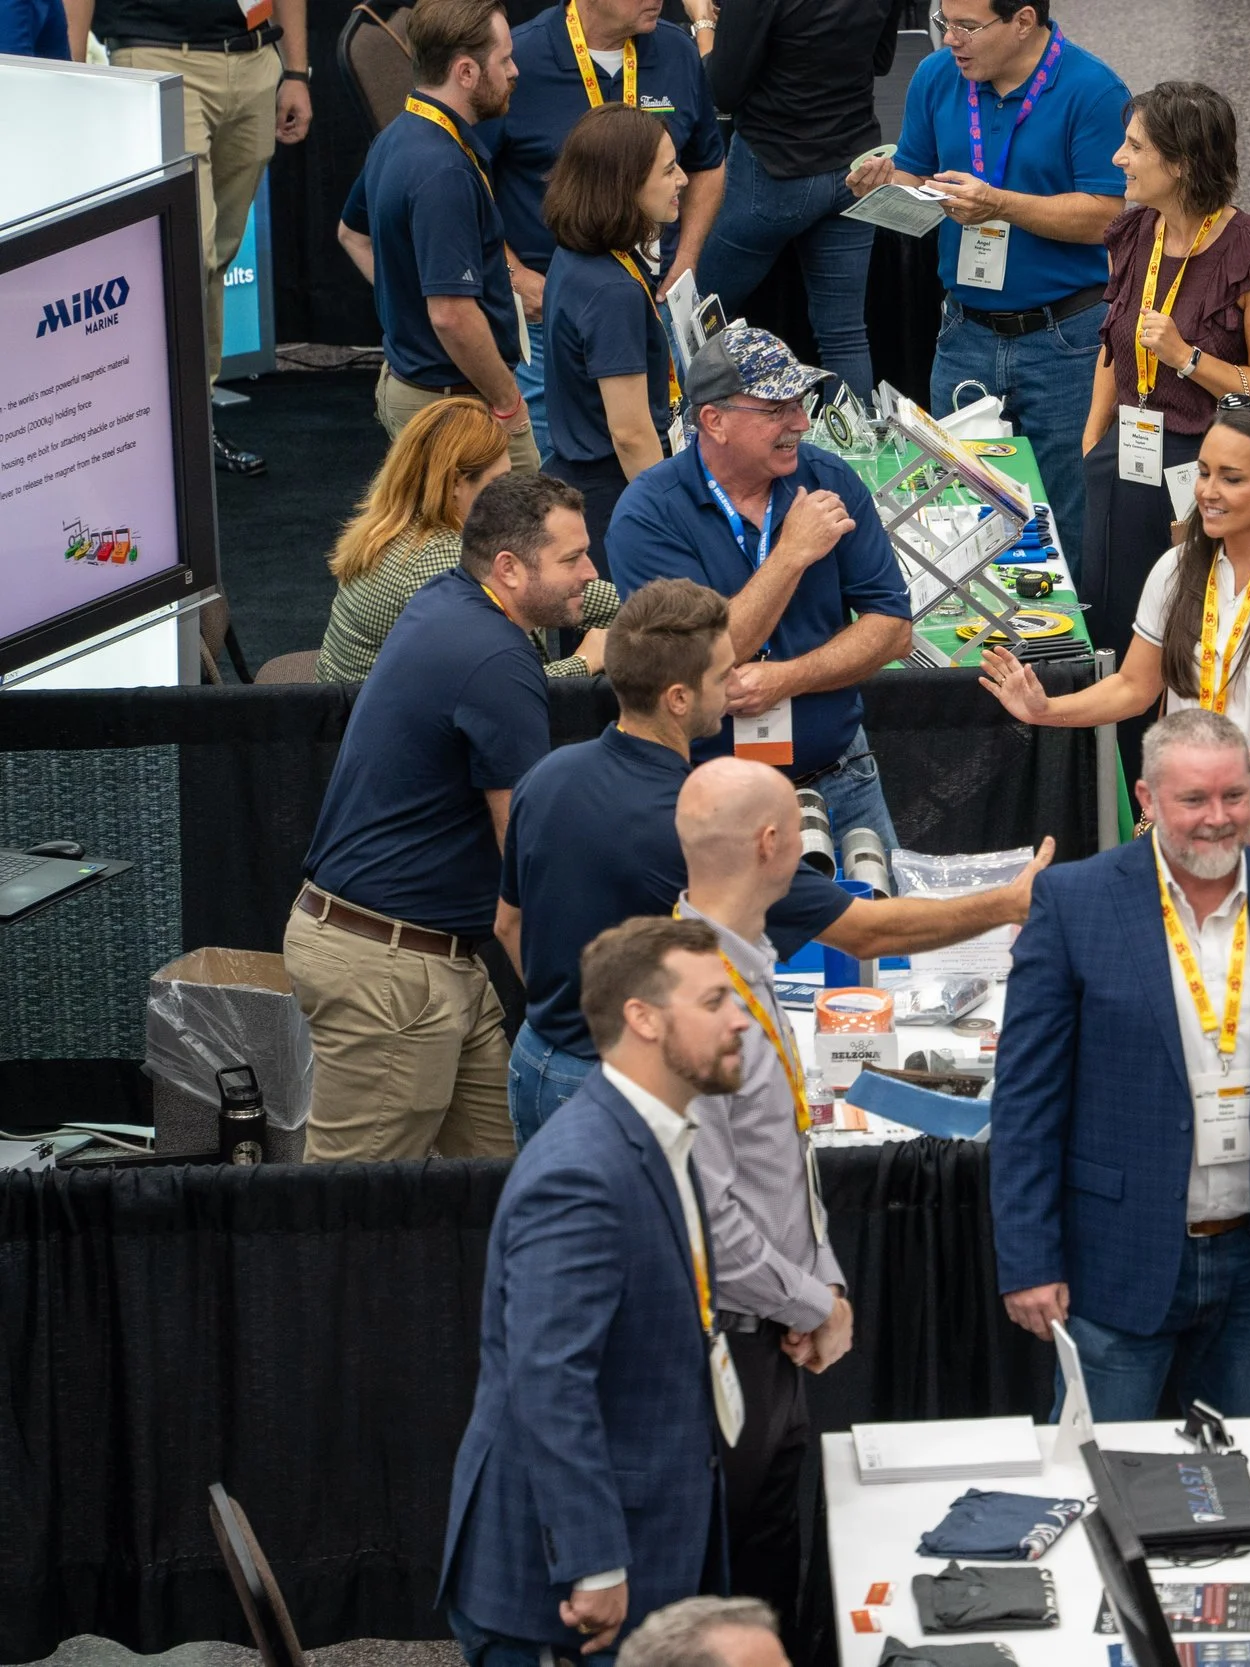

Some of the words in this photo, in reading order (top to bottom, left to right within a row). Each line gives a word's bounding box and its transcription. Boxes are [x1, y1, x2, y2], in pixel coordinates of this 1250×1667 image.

[223, 266, 255, 287] ults
[85, 313, 119, 336] MARINE
[7, 401, 18, 411] the
[18, 392, 39, 407] world's
[40, 386, 55, 399] most
[55, 374, 80, 395] powerful
[81, 365, 107, 381] magnetic
[107, 354, 130, 372] material
[5, 425, 27, 443] pounds
[55, 405, 77, 421] holding
[77, 400, 93, 412] force
[27, 450, 38, 463] eye
[38, 444, 50, 457] bolt
[50, 440, 59, 452] for
[60, 431, 87, 448] attaching
[87, 421, 108, 438] shackle
[109, 419, 115, 429] or
[116, 412, 135, 426] binder
[135, 405, 151, 420] strap
[15, 486, 22, 495] to
[22, 477, 43, 492] release
[43, 472, 54, 484] the
[54, 463, 76, 478] magnet
[76, 458, 91, 470] from
[91, 453, 101, 465] the
[101, 446, 116, 460] steel
[116, 439, 137, 455] surface
[831, 1051, 881, 1060] BELZONA
